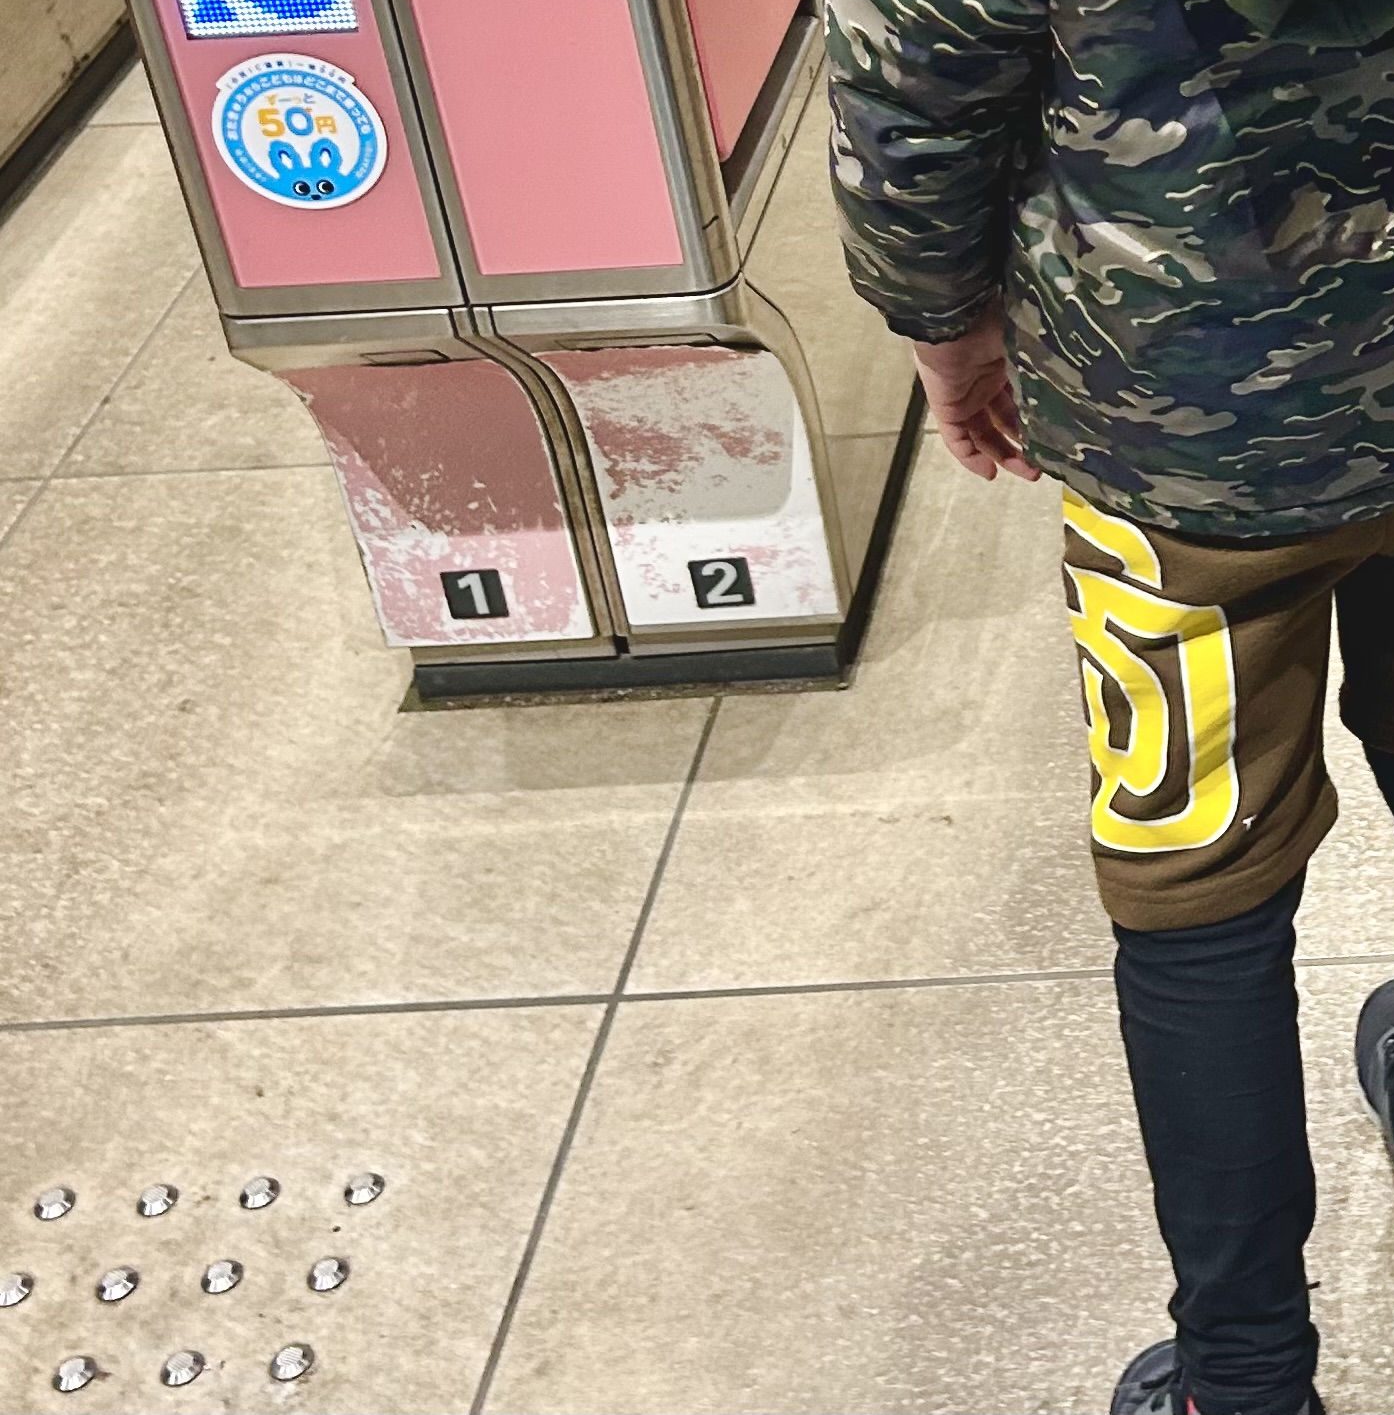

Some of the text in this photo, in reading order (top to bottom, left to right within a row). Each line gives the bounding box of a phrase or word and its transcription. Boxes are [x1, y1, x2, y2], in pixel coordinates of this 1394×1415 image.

[257, 106, 339, 138] 50円
[456, 572, 491, 616] 1
[703, 560, 744, 605] 2
